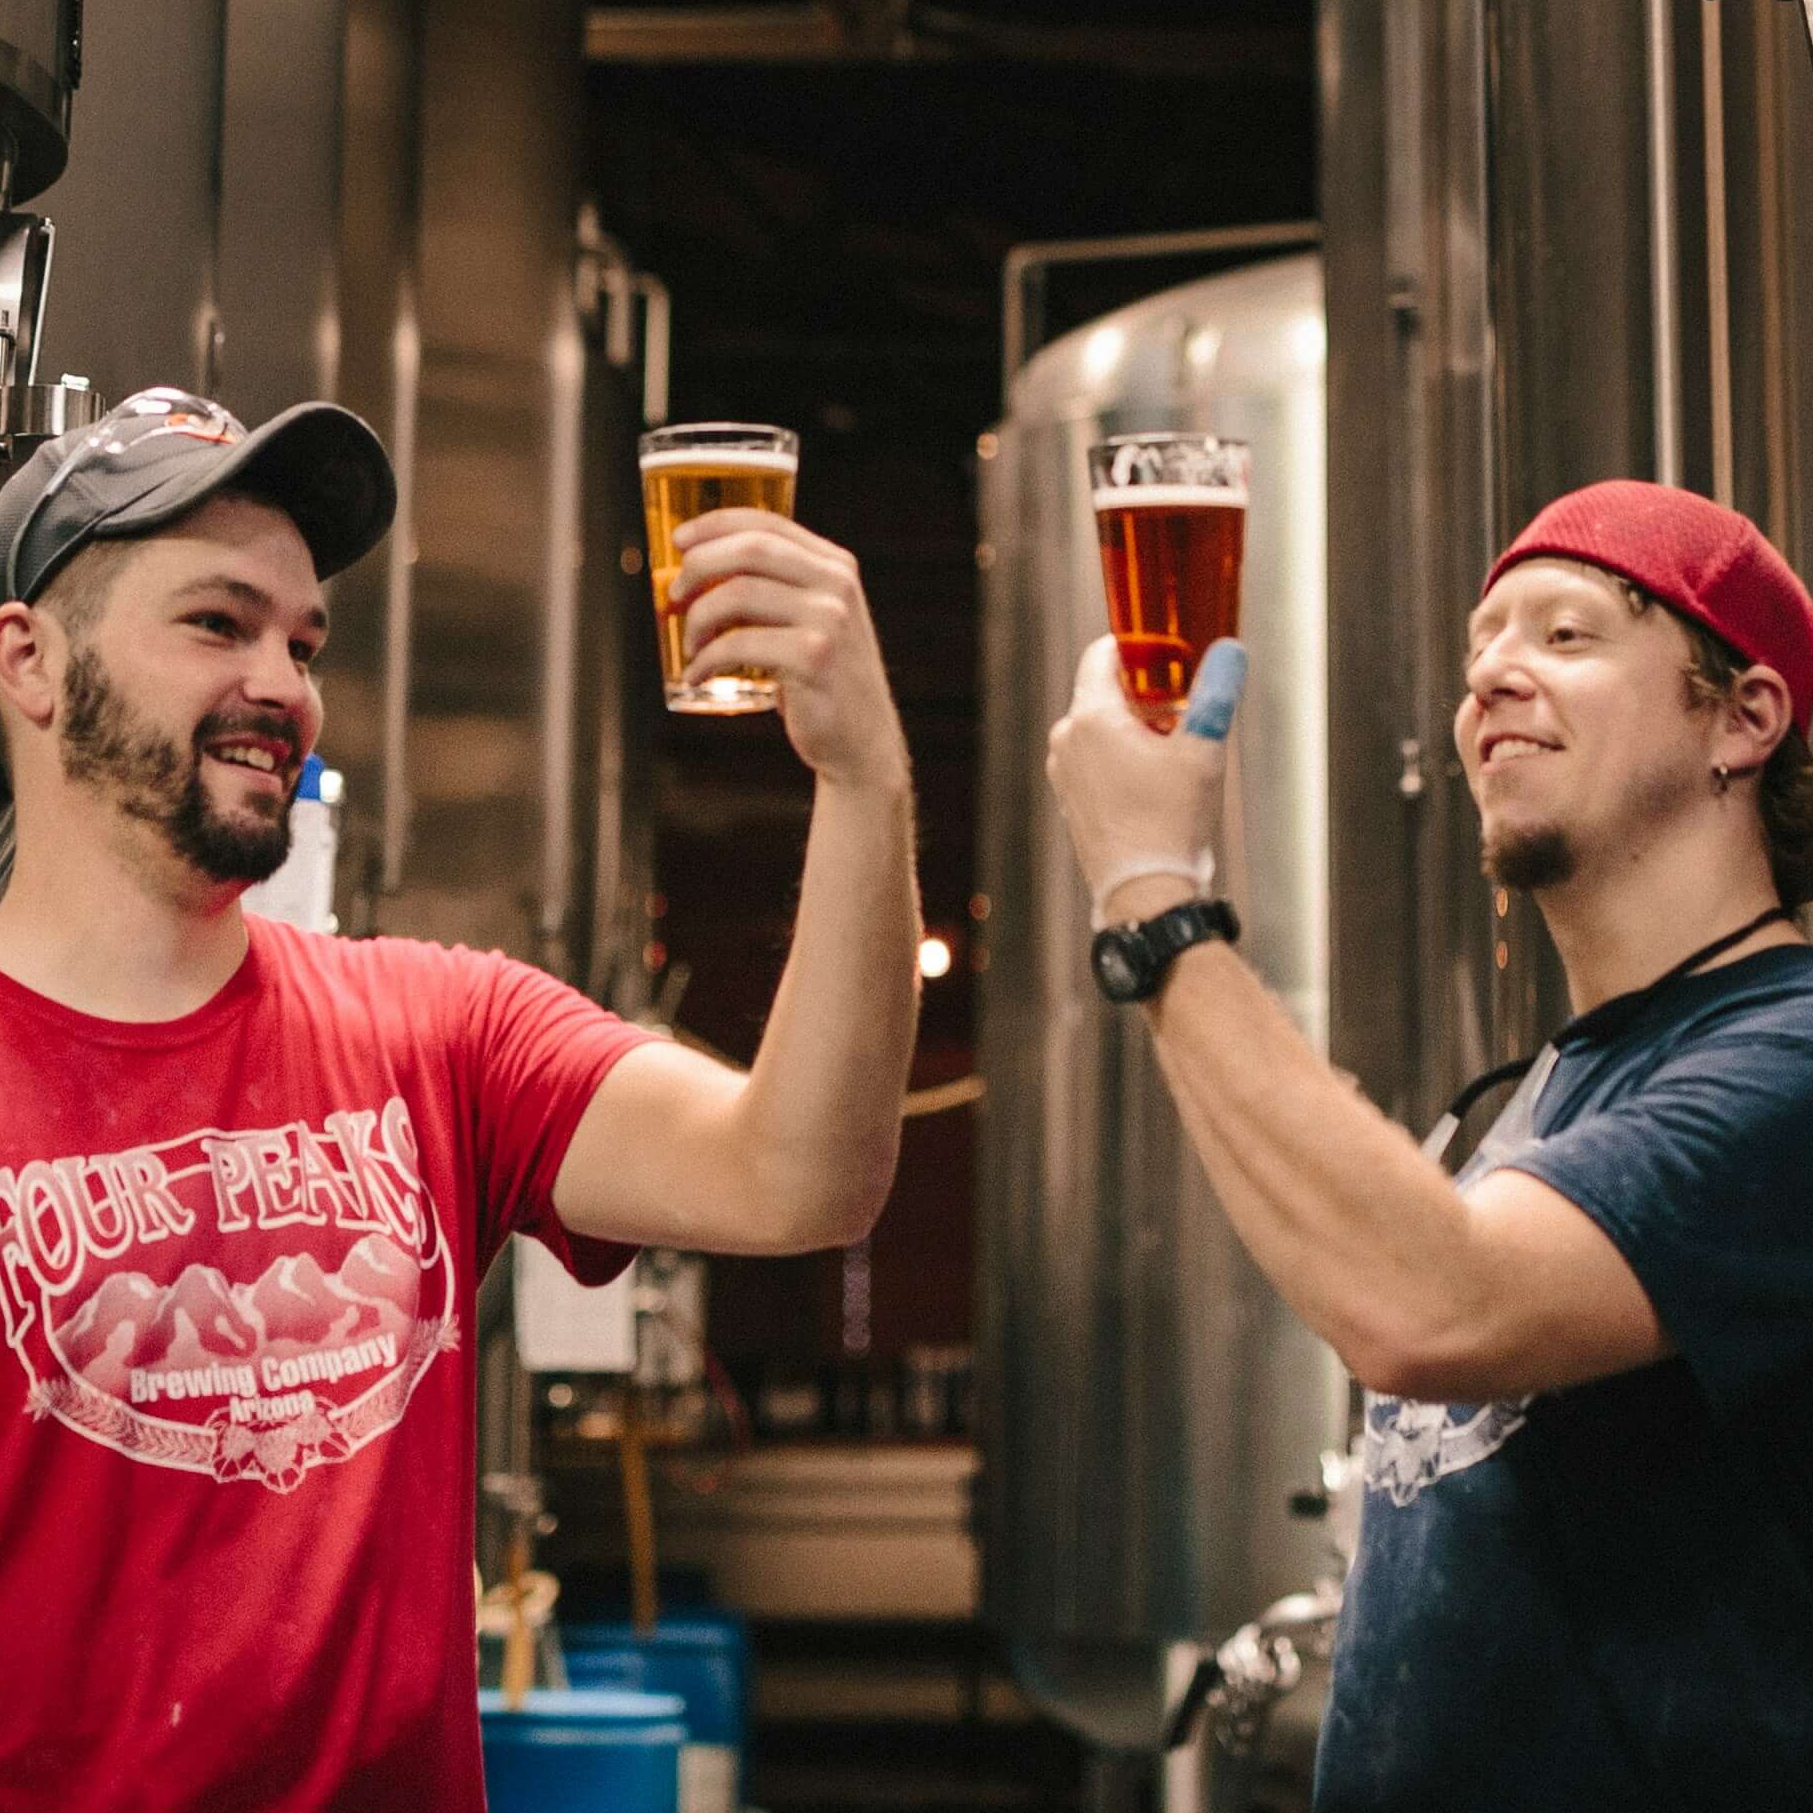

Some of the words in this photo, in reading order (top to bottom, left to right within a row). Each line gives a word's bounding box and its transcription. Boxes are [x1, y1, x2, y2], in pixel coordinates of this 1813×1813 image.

[200, 1095, 439, 1269] PEAKS
[130, 1362, 258, 1404] Brewing
[261, 1332, 397, 1392] Company
[229, 1388, 317, 1424] Arizona
